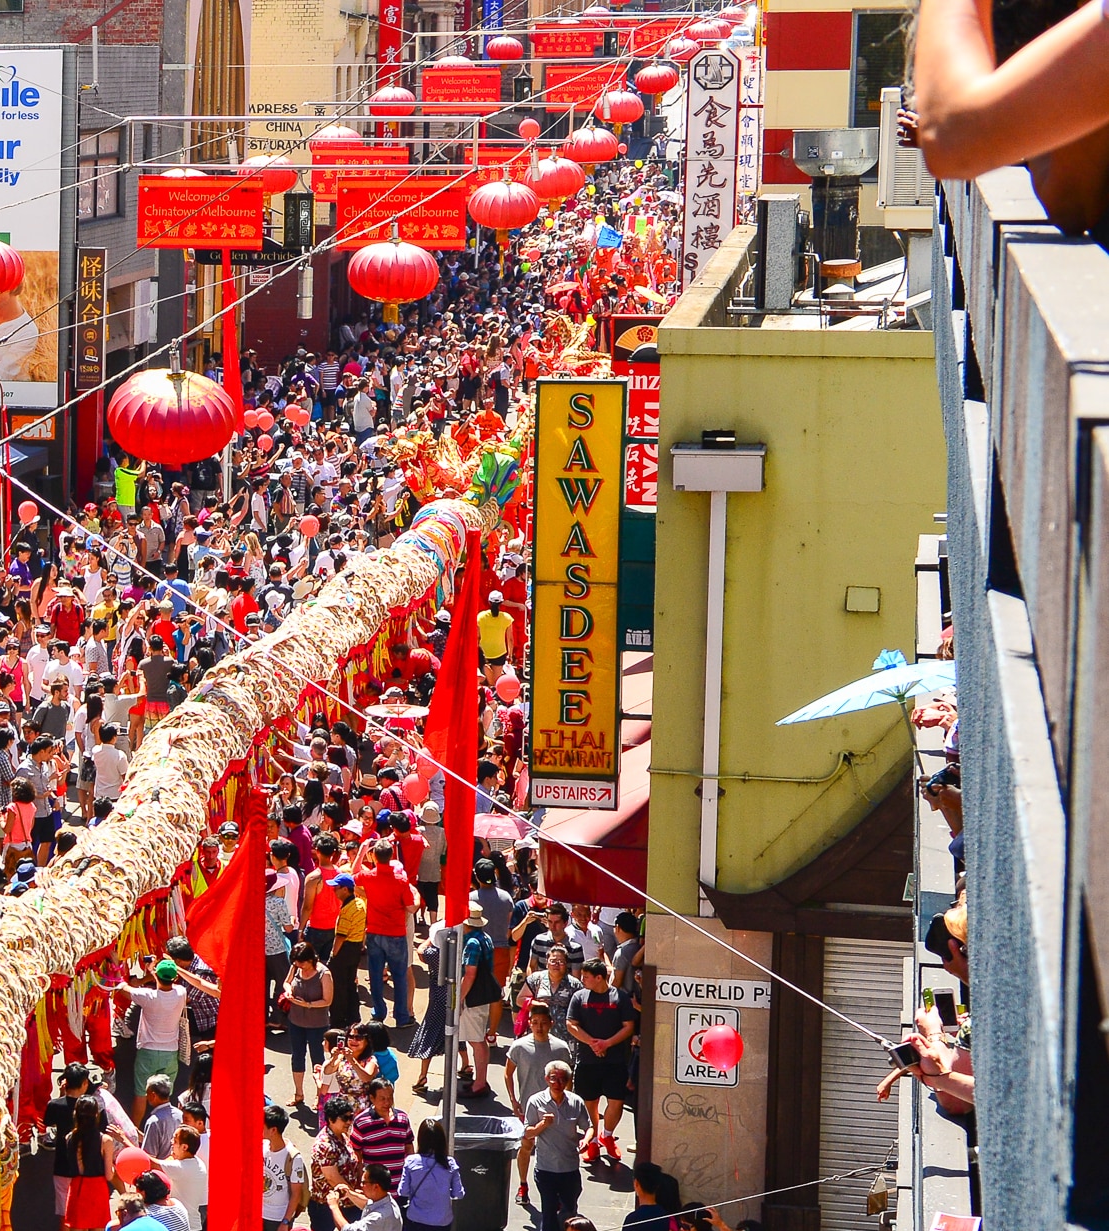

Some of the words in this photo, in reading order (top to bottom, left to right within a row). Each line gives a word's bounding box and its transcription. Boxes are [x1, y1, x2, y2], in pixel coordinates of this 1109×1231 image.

[441, 77, 471, 85] Welcome
[472, 77, 480, 85] to
[1, 111, 16, 121] for
[17, 111, 40, 121] less
[266, 122, 303, 137] CHINA
[168, 189, 216, 202] Welcome
[218, 190, 230, 202] to
[368, 191, 414, 203] Welcome
[417, 192, 431, 203] to
[144, 204, 198, 217] Chinatown
[201, 204, 256, 217] Melbourne
[344, 206, 398, 218] Chinatown
[403, 206, 459, 218] Melbourne
[254, 251, 296, 260] Orchids
[555, 392, 604, 727] SAWASDEE
[540, 729, 606, 750] THAI
[533, 749, 613, 769] RESTAURANT
[535, 784, 597, 801] UPSTAIRS
[659, 982, 744, 1001] COVERLID
[685, 1065, 728, 1079] AREA
